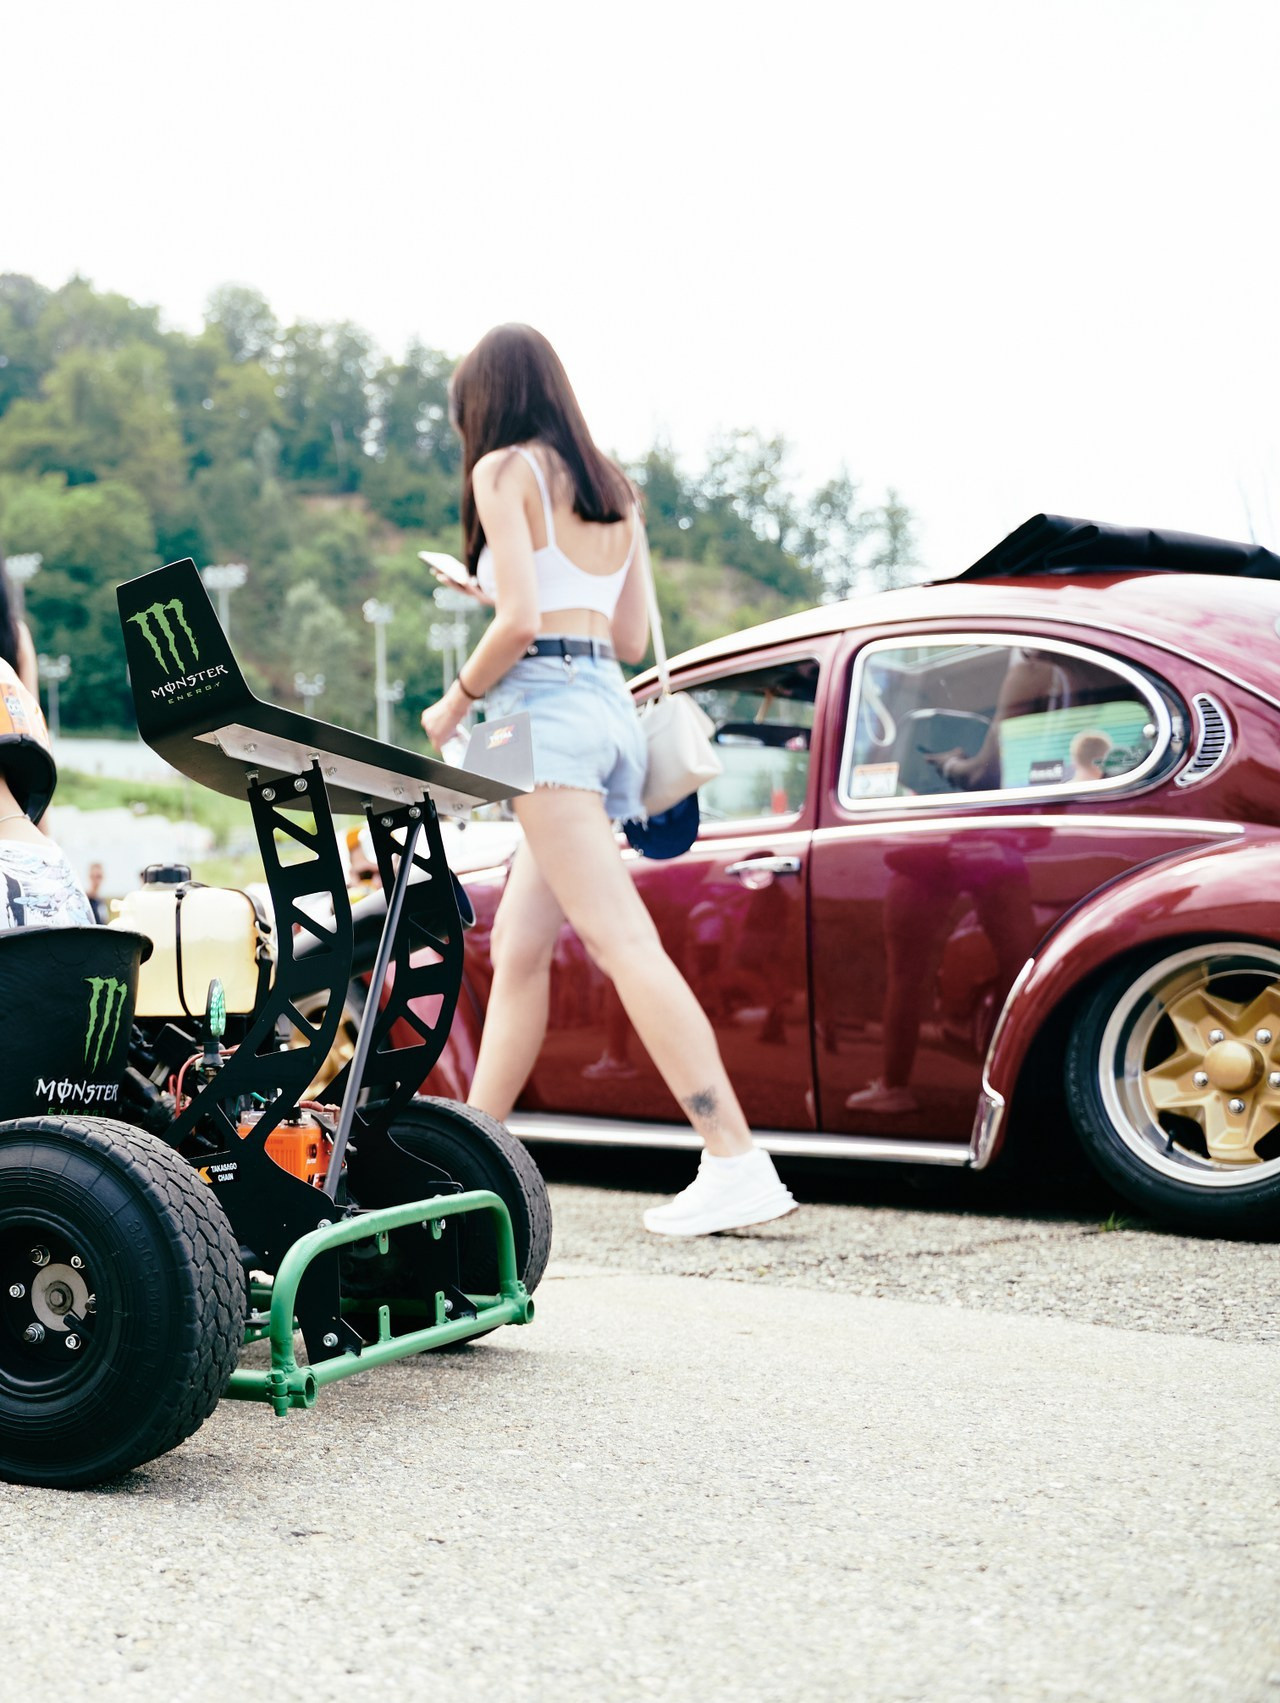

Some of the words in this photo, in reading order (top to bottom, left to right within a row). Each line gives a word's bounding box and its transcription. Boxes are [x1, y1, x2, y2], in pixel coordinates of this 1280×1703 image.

[167, 681, 220, 705] ENERGY
[211, 1162, 237, 1173] TAKASAGO
[218, 1173, 234, 1182] CHAIN
